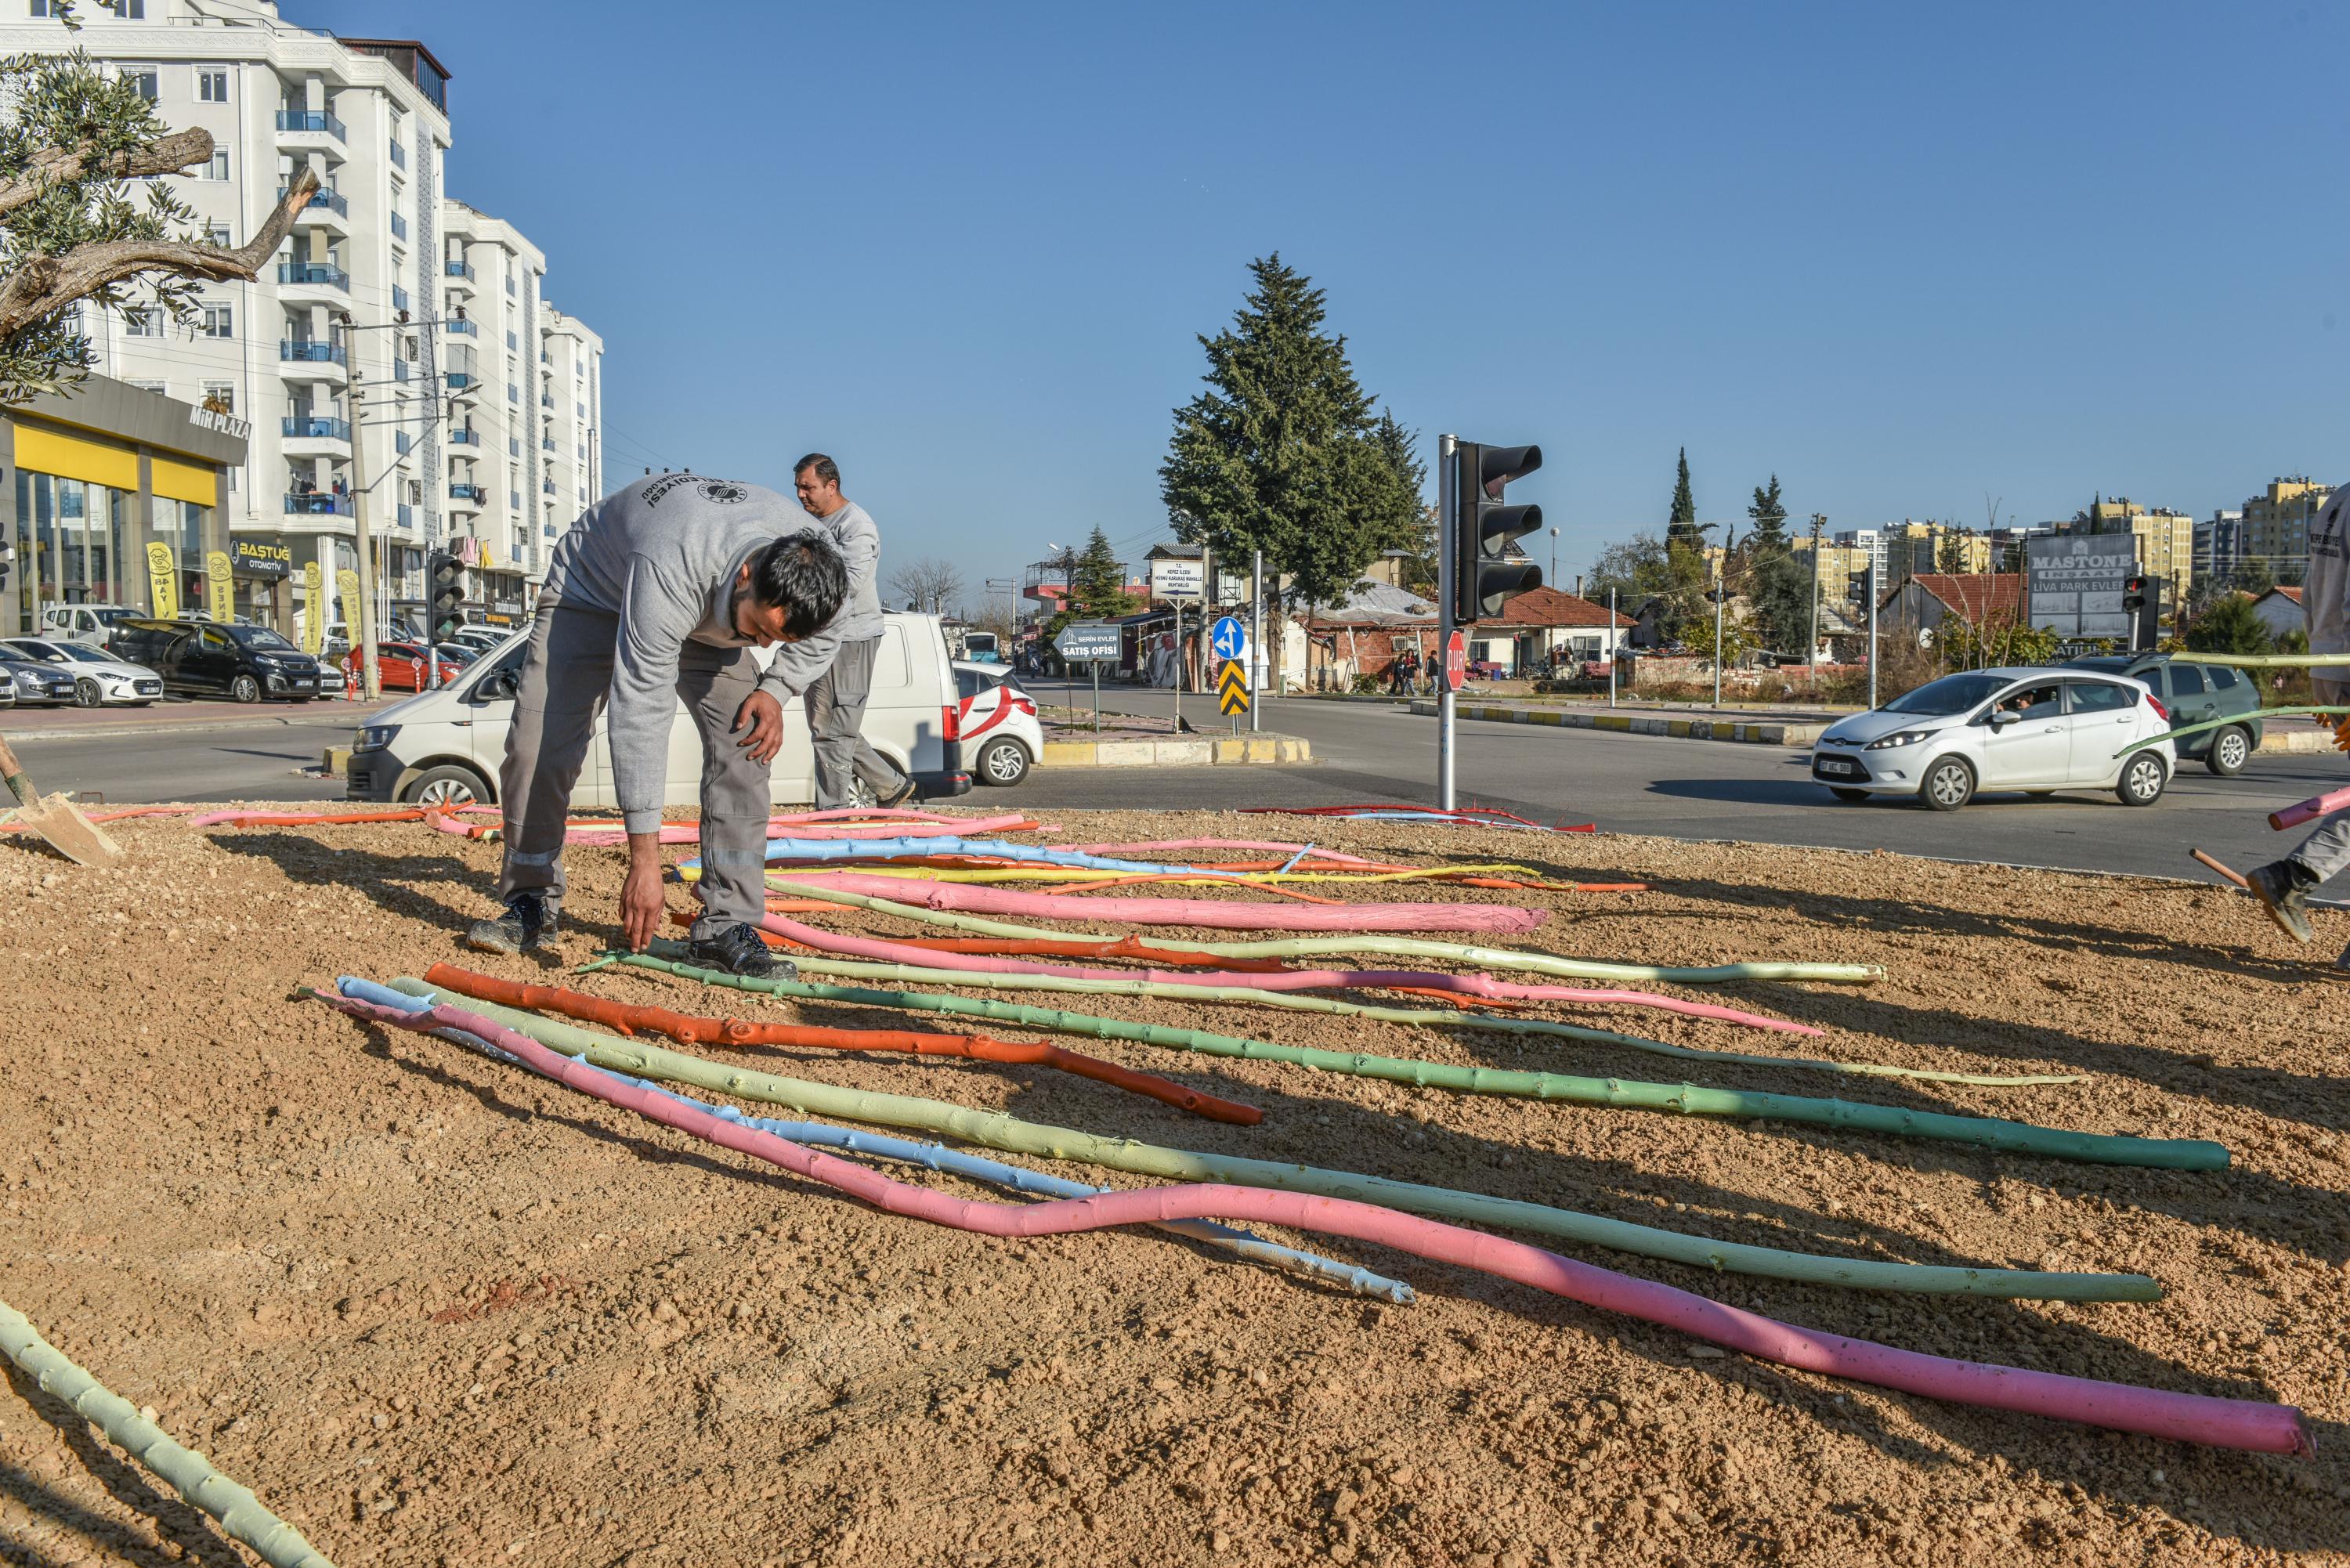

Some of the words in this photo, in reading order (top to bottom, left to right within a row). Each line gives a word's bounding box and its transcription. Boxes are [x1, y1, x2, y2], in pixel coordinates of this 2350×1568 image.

[213, 413, 250, 440] PLAZA
[239, 542, 289, 561] BAŞTUĞ
[248, 559, 282, 571] OTOMOTİV
[2032, 555, 2132, 569] MASTONE
[2034, 581, 2057, 591] LİVA
[2060, 582, 2088, 591] PARK
[1062, 647, 1090, 658] SATIŞ
[1091, 644, 1117, 655] OFİSİ
[1448, 649, 1463, 671] DUR
